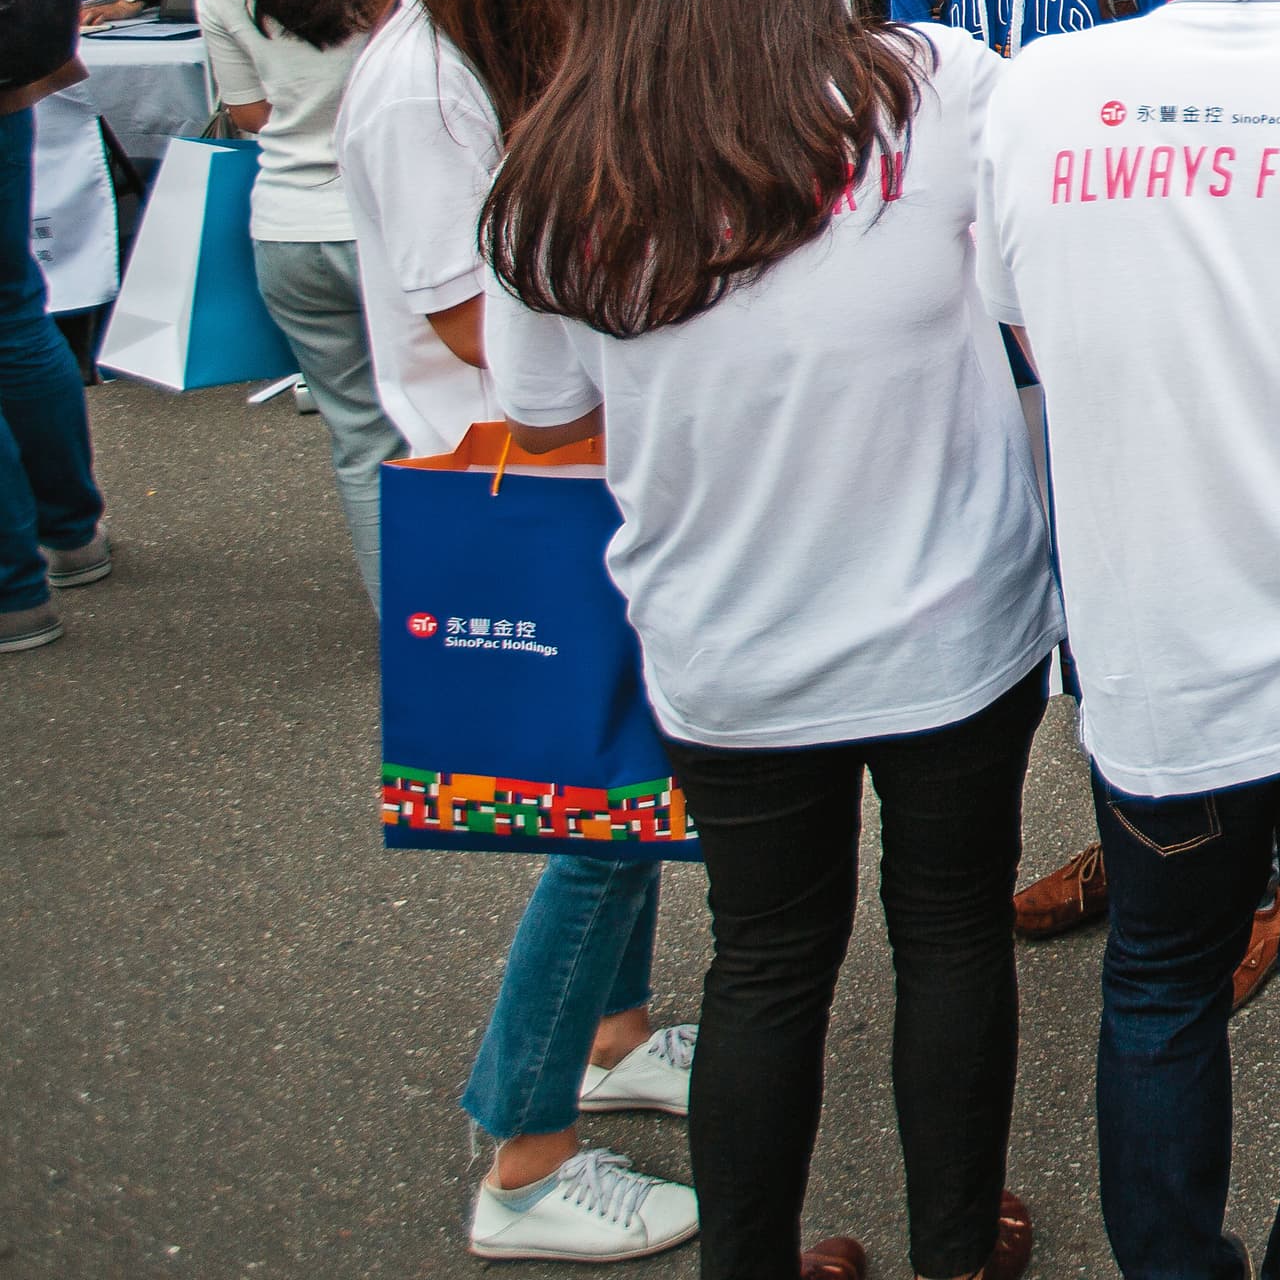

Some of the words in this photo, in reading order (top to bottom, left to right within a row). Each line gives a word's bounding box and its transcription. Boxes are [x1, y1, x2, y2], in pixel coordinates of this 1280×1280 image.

[1136, 104, 1224, 123] 永豐金控
[1052, 146, 1236, 204] ALWAYS
[446, 616, 537, 639] 永豐金控
[445, 636, 500, 650] SinoPac
[502, 639, 559, 656] Holdings
